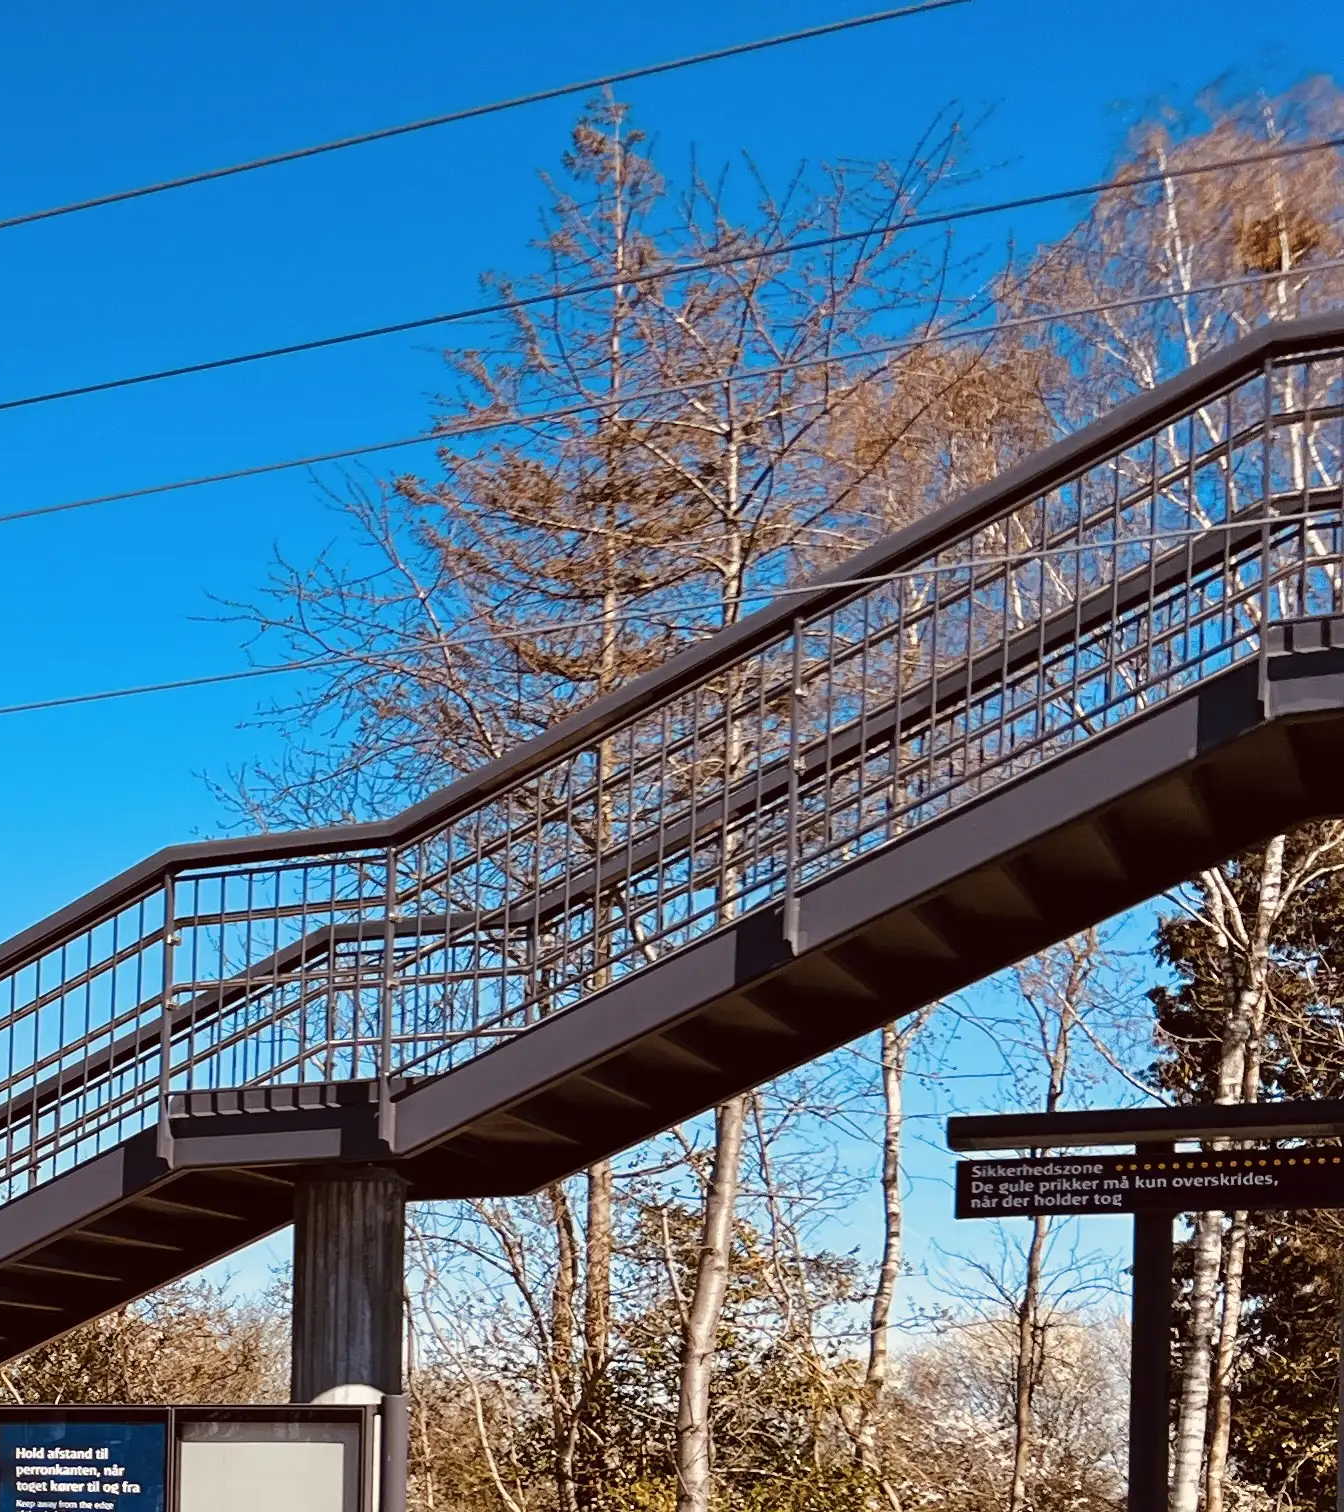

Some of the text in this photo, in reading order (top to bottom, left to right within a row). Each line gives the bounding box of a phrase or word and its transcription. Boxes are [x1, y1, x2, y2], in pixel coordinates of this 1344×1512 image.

[971, 1163, 1104, 1178] Sikkerhedszone
[971, 1172, 1280, 1195] De gule prikker må kun overskrides,
[970, 1193, 1123, 1209] når der holder tog
[15, 1447, 109, 1460] Hold afstand til
[15, 1464, 126, 1477] perronkanten, når
[16, 1480, 141, 1495] toget kører til og fra
[15, 1499, 36, 1509] Keep
[58, 1500, 78, 1509] from
